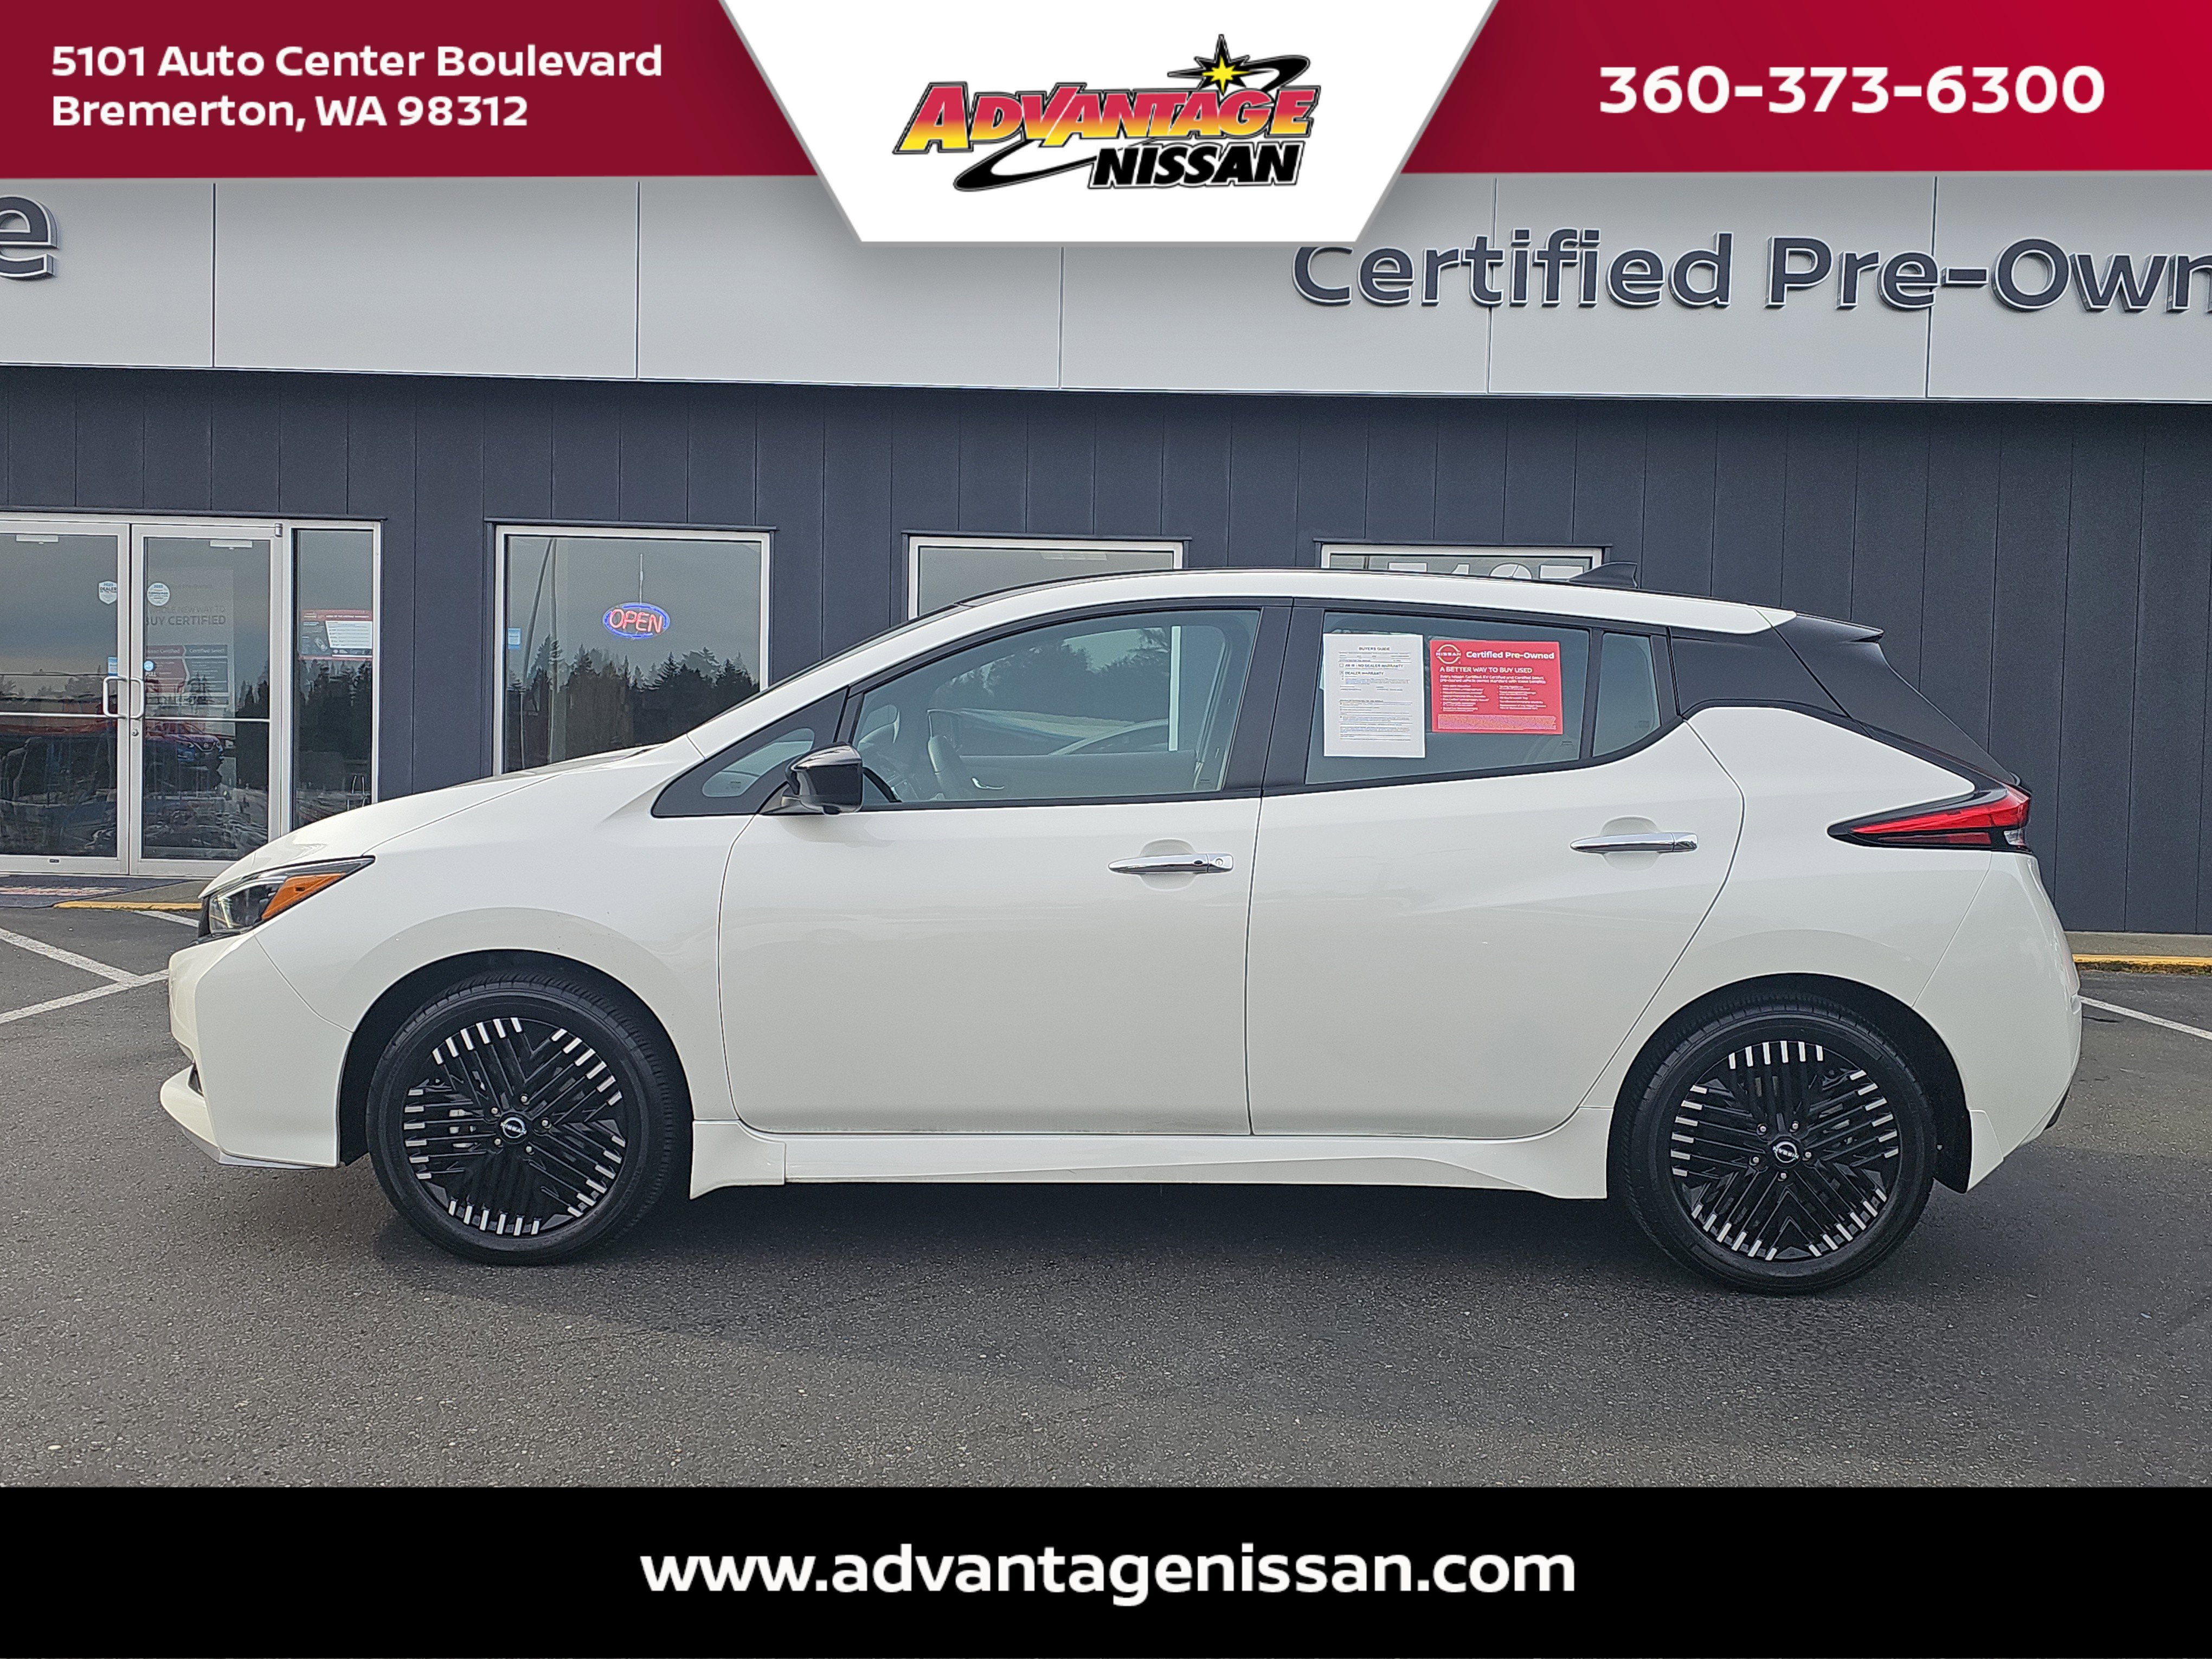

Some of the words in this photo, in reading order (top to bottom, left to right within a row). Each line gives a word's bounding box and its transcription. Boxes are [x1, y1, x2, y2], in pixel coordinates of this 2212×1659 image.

[1292, 227, 1734, 307] Certified
[168, 615, 227, 626] CERTIFIED
[609, 608, 663, 633] OPEN
[1465, 650, 1503, 659] Certified
[1505, 652, 1555, 660] Pre-Owned
